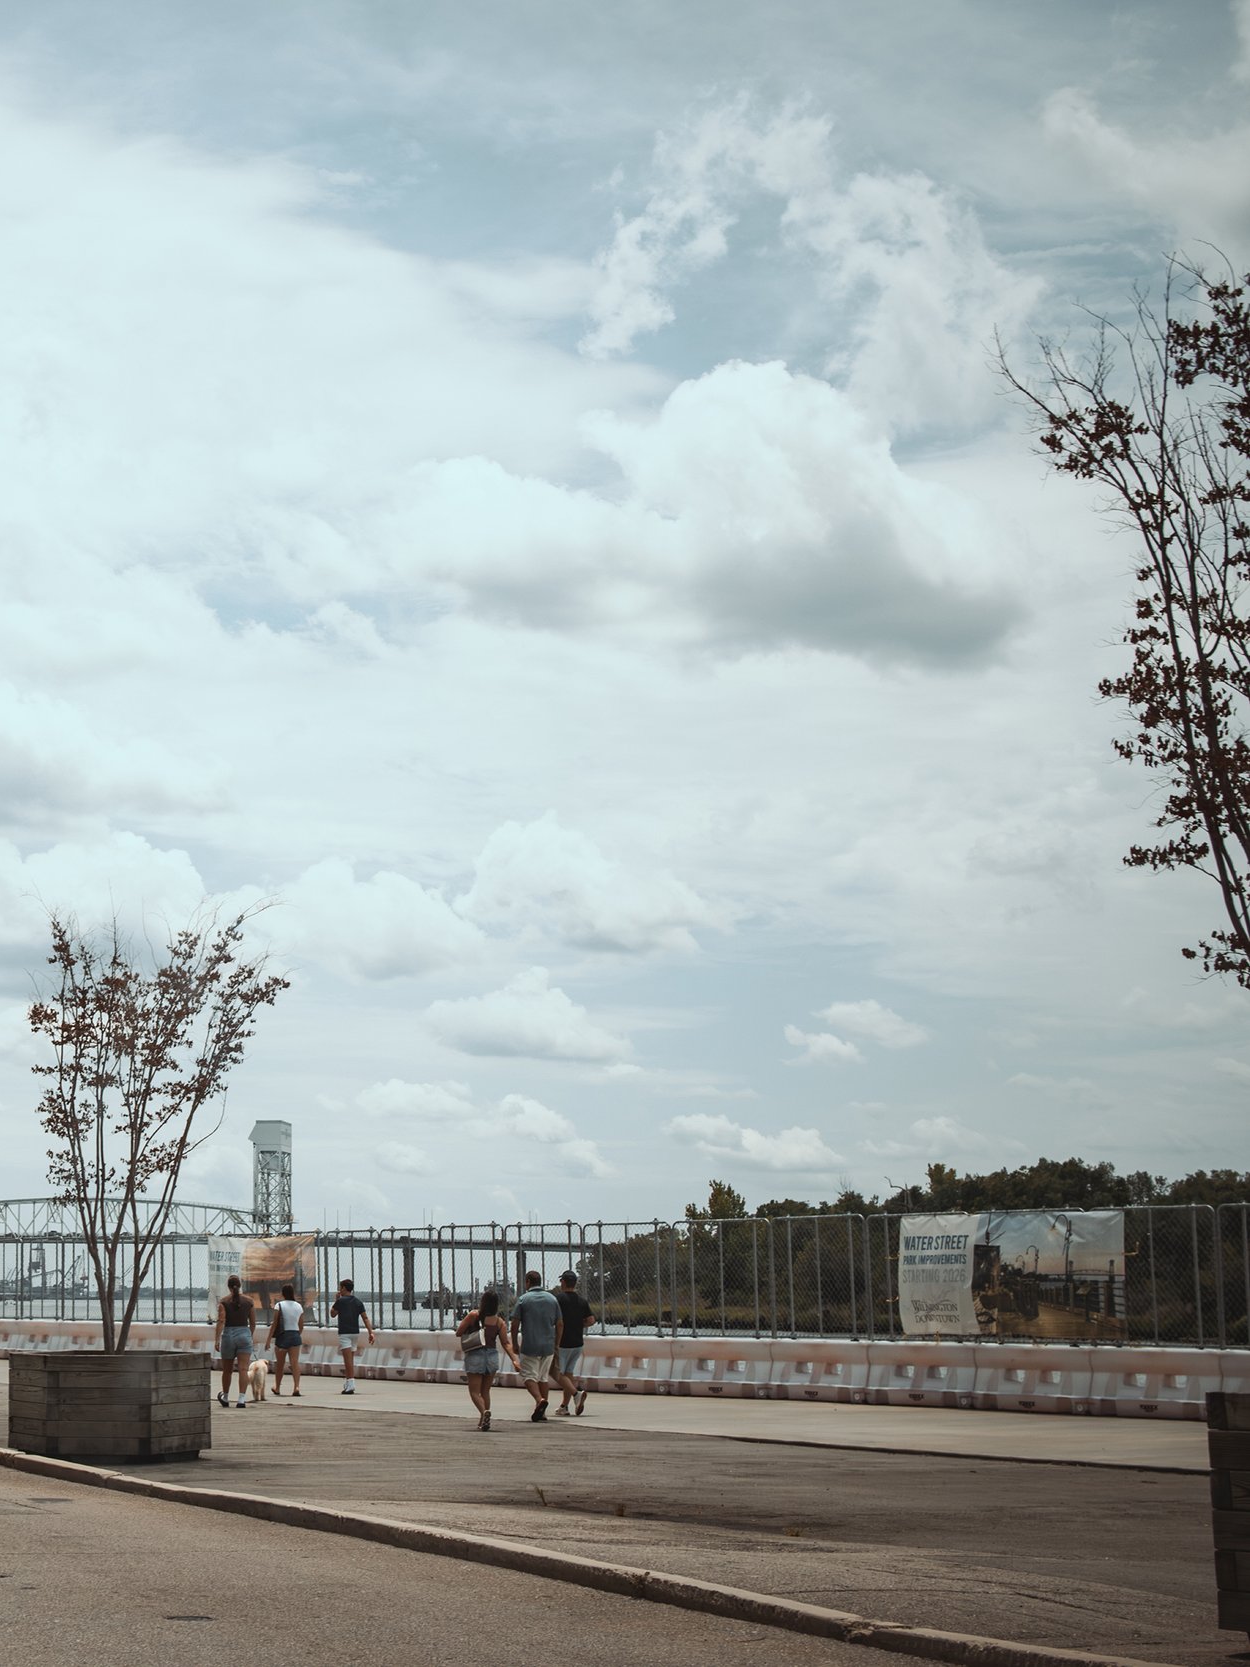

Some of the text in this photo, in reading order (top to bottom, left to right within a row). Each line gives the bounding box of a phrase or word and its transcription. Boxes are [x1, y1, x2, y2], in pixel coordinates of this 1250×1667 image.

[903, 1234, 969, 1251] WATER STREET
[903, 1254, 967, 1265] PARK IMPROVEMENTS
[902, 1268, 967, 1283] STARTING 2026
